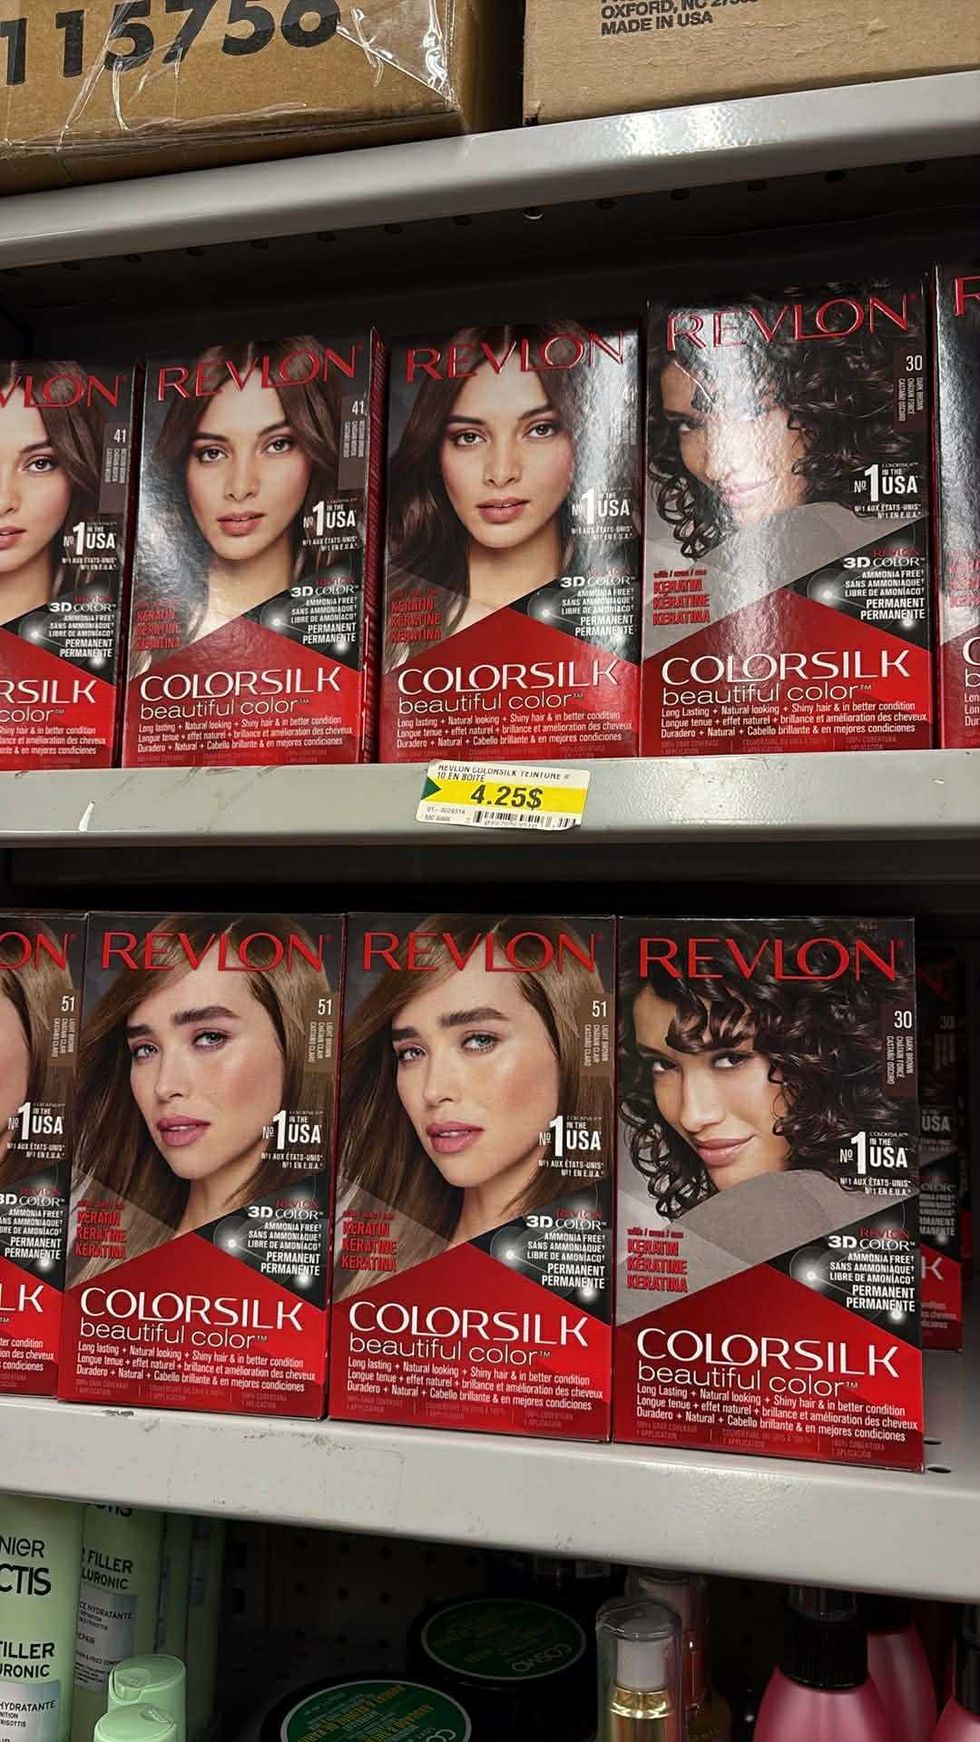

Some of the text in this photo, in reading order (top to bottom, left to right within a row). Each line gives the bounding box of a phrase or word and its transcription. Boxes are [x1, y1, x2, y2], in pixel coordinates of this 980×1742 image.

[601, 11, 713, 36] MADE IN USA
[666, 294, 908, 352] REVLON
[405, 329, 624, 384] REVLON
[905, 354, 923, 372] 30
[157, 344, 357, 402] REVLON
[351, 400, 365, 415] 41
[113, 428, 127, 444] 41
[842, 556, 870, 569] 3D
[560, 575, 585, 588] 3D
[290, 586, 313, 598] 3D
[49, 602, 72, 613] 3D
[865, 597, 925, 609] PERMANENT
[580, 614, 633, 626] PERMANENT
[860, 608, 926, 621] PERMANENTE
[307, 622, 357, 634] PERMANENT
[574, 625, 634, 637] PERMANENTE
[65, 638, 113, 648] PERMANENT
[302, 633, 357, 645] PERMANENTE
[59, 648, 113, 658] PERMANENTE
[661, 649, 911, 687] COLORSILK
[140, 666, 341, 702] COLORSILK
[397, 660, 619, 696] COLORSILK
[398, 692, 502, 715] beautiful
[662, 683, 780, 707] beautiful
[140, 699, 234, 721] beautiful
[661, 708, 680, 719] Long
[682, 707, 710, 718] Lasting
[721, 705, 750, 715] Natural
[751, 705, 780, 715] looking
[791, 703, 814, 714] Shiny
[816, 702, 831, 712] hair
[842, 702, 850, 711] in
[852, 701, 876, 711] better
[878, 701, 915, 711] condition
[448, 772, 459, 780] EN
[461, 773, 486, 782] BOITE
[470, 784, 543, 811] 4.25$
[100, 930, 323, 974] REVLON
[362, 930, 595, 975] REVLON
[639, 937, 895, 981] REVLON
[61, 995, 76, 1012] 51
[317, 998, 332, 1015] 51
[592, 1000, 607, 1018] 51
[894, 1010, 913, 1029] 30
[869, 1138, 892, 1146] IN THE
[247, 1206, 273, 1219] 3D
[525, 1215, 553, 1229] 3D
[9, 1235, 62, 1249] PERMANENT
[828, 1235, 858, 1249] 3D
[4, 1247, 62, 1261] PERMANENTE
[266, 1251, 321, 1265] PERMANENT
[847, 1252, 889, 1264] AMMONIA
[260, 1262, 320, 1277] PERMANENTE
[547, 1263, 606, 1278] PERMANENT
[829, 1261, 852, 1272] SANS
[541, 1275, 606, 1290] PERMANENTE
[829, 1271, 854, 1282] LIBRE
[854, 1272, 866, 1283] DE
[852, 1284, 916, 1300] PERMANENT
[80, 1286, 304, 1332] COLORSILK
[846, 1296, 916, 1313] PERMANENTE
[79, 1317, 185, 1344] beautiful
[349, 1300, 589, 1348] COLORSILK
[349, 1331, 462, 1361] beautiful
[637, 1327, 900, 1379] COLORSILK
[638, 1359, 761, 1391] beautiful
[637, 1382, 906, 1417] Long Lasting Natural looking Shiny hair & in better condition
[637, 1394, 666, 1409] Longue
[668, 1397, 691, 1410] tenue
[701, 1401, 720, 1412] effet
[722, 1403, 752, 1416] naturel
[762, 1406, 798, 1419] brillance
[800, 1410, 808, 1420] et
[864, 1415, 881, 1428] des
[881, 1418, 919, 1431] cheveux
[636, 1406, 906, 1442] Duradero Natural Cabello brillante & en mejores condiciones
[87, 1549, 134, 1574] FILLER
